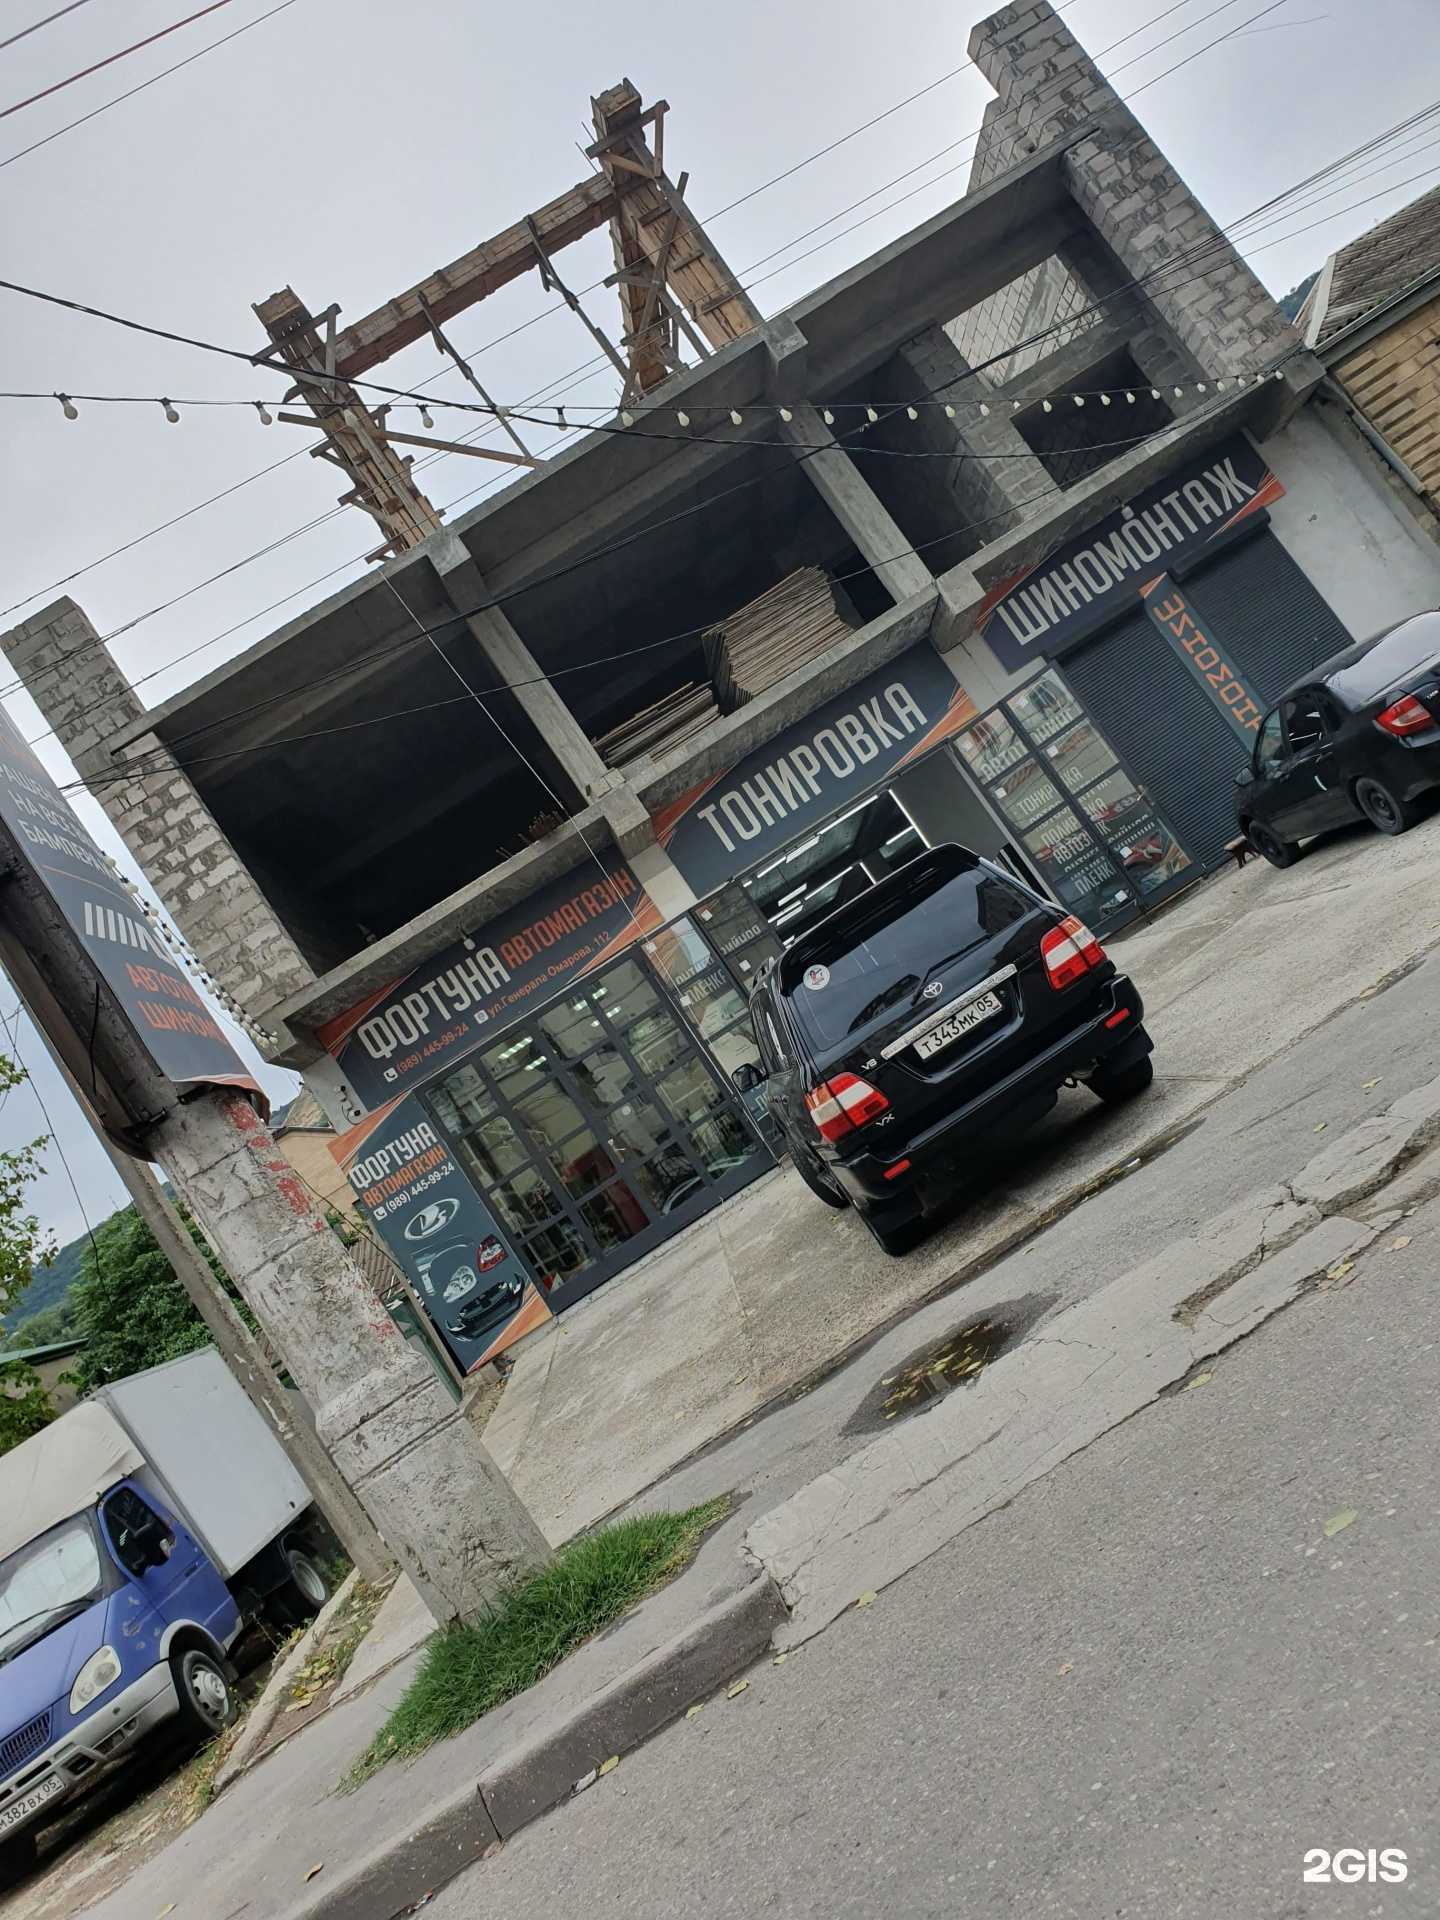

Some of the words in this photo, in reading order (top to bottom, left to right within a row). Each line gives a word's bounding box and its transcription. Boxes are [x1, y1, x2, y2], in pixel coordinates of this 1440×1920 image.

[998, 457, 1257, 646] ШИНОМОНТАЖ
[697, 682, 928, 853] ТОНИРОВКА
[357, 946, 511, 1059] ФОРТУНА
[500, 868, 637, 969] АВТОМАГАЗИН
[976, 995, 994, 1012] 05
[397, 1051, 423, 1075] (989)
[424, 1023, 470, 1057] 445-99-24
[876, 1113, 895, 1127] VX
[350, 1121, 438, 1189] ФОРТУНА
[363, 1144, 448, 1208] АВТОМАГАЗИН
[387, 1189, 411, 1212] (989)
[411, 1163, 455, 1196] 445-99-24
[42, 1779, 57, 1793] 05
